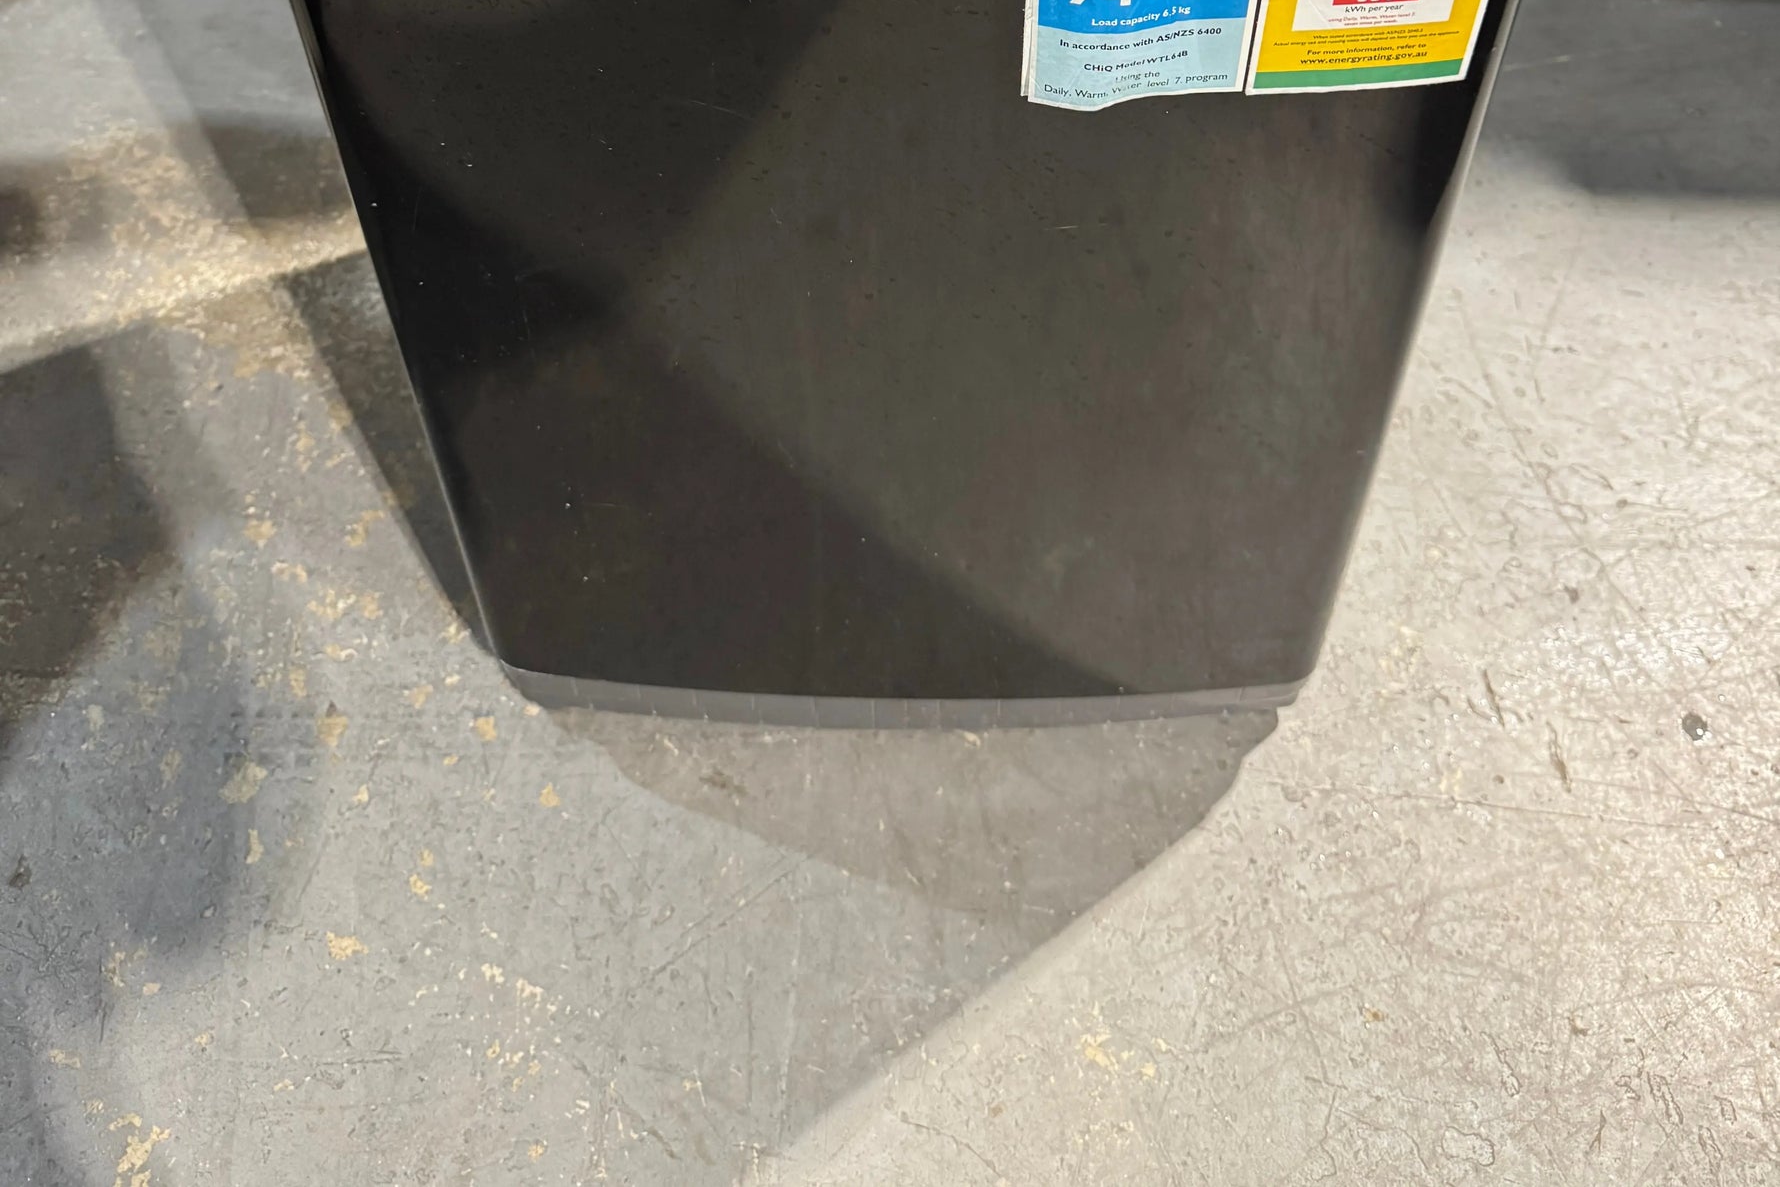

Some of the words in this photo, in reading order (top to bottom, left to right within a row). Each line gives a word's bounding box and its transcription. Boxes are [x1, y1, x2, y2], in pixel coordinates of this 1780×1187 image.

[1345, 5, 1366, 13] kWh
[1385, 4, 1404, 12] year
[1091, 18, 1118, 27] Load
[1120, 13, 1161, 27] capacity
[1162, 6, 1177, 17] 6.5
[1178, 6, 1191, 15] kg
[1059, 39, 1070, 48] In
[1072, 43, 1130, 51] accordance
[1132, 38, 1154, 48] with
[1156, 28, 1195, 43] AS/NZS
[1197, 27, 1222, 35] 6400
[1346, 45, 1395, 54] information,
[1083, 63, 1113, 72] CHiQ
[1115, 59, 1145, 70] Model
[1147, 50, 1188, 64] WTL64B
[1300, 51, 1428, 65] www.energyrating.gov.au
[1144, 70, 1160, 78] the
[1147, 79, 1169, 87] level
[1185, 73, 1228, 82] program
